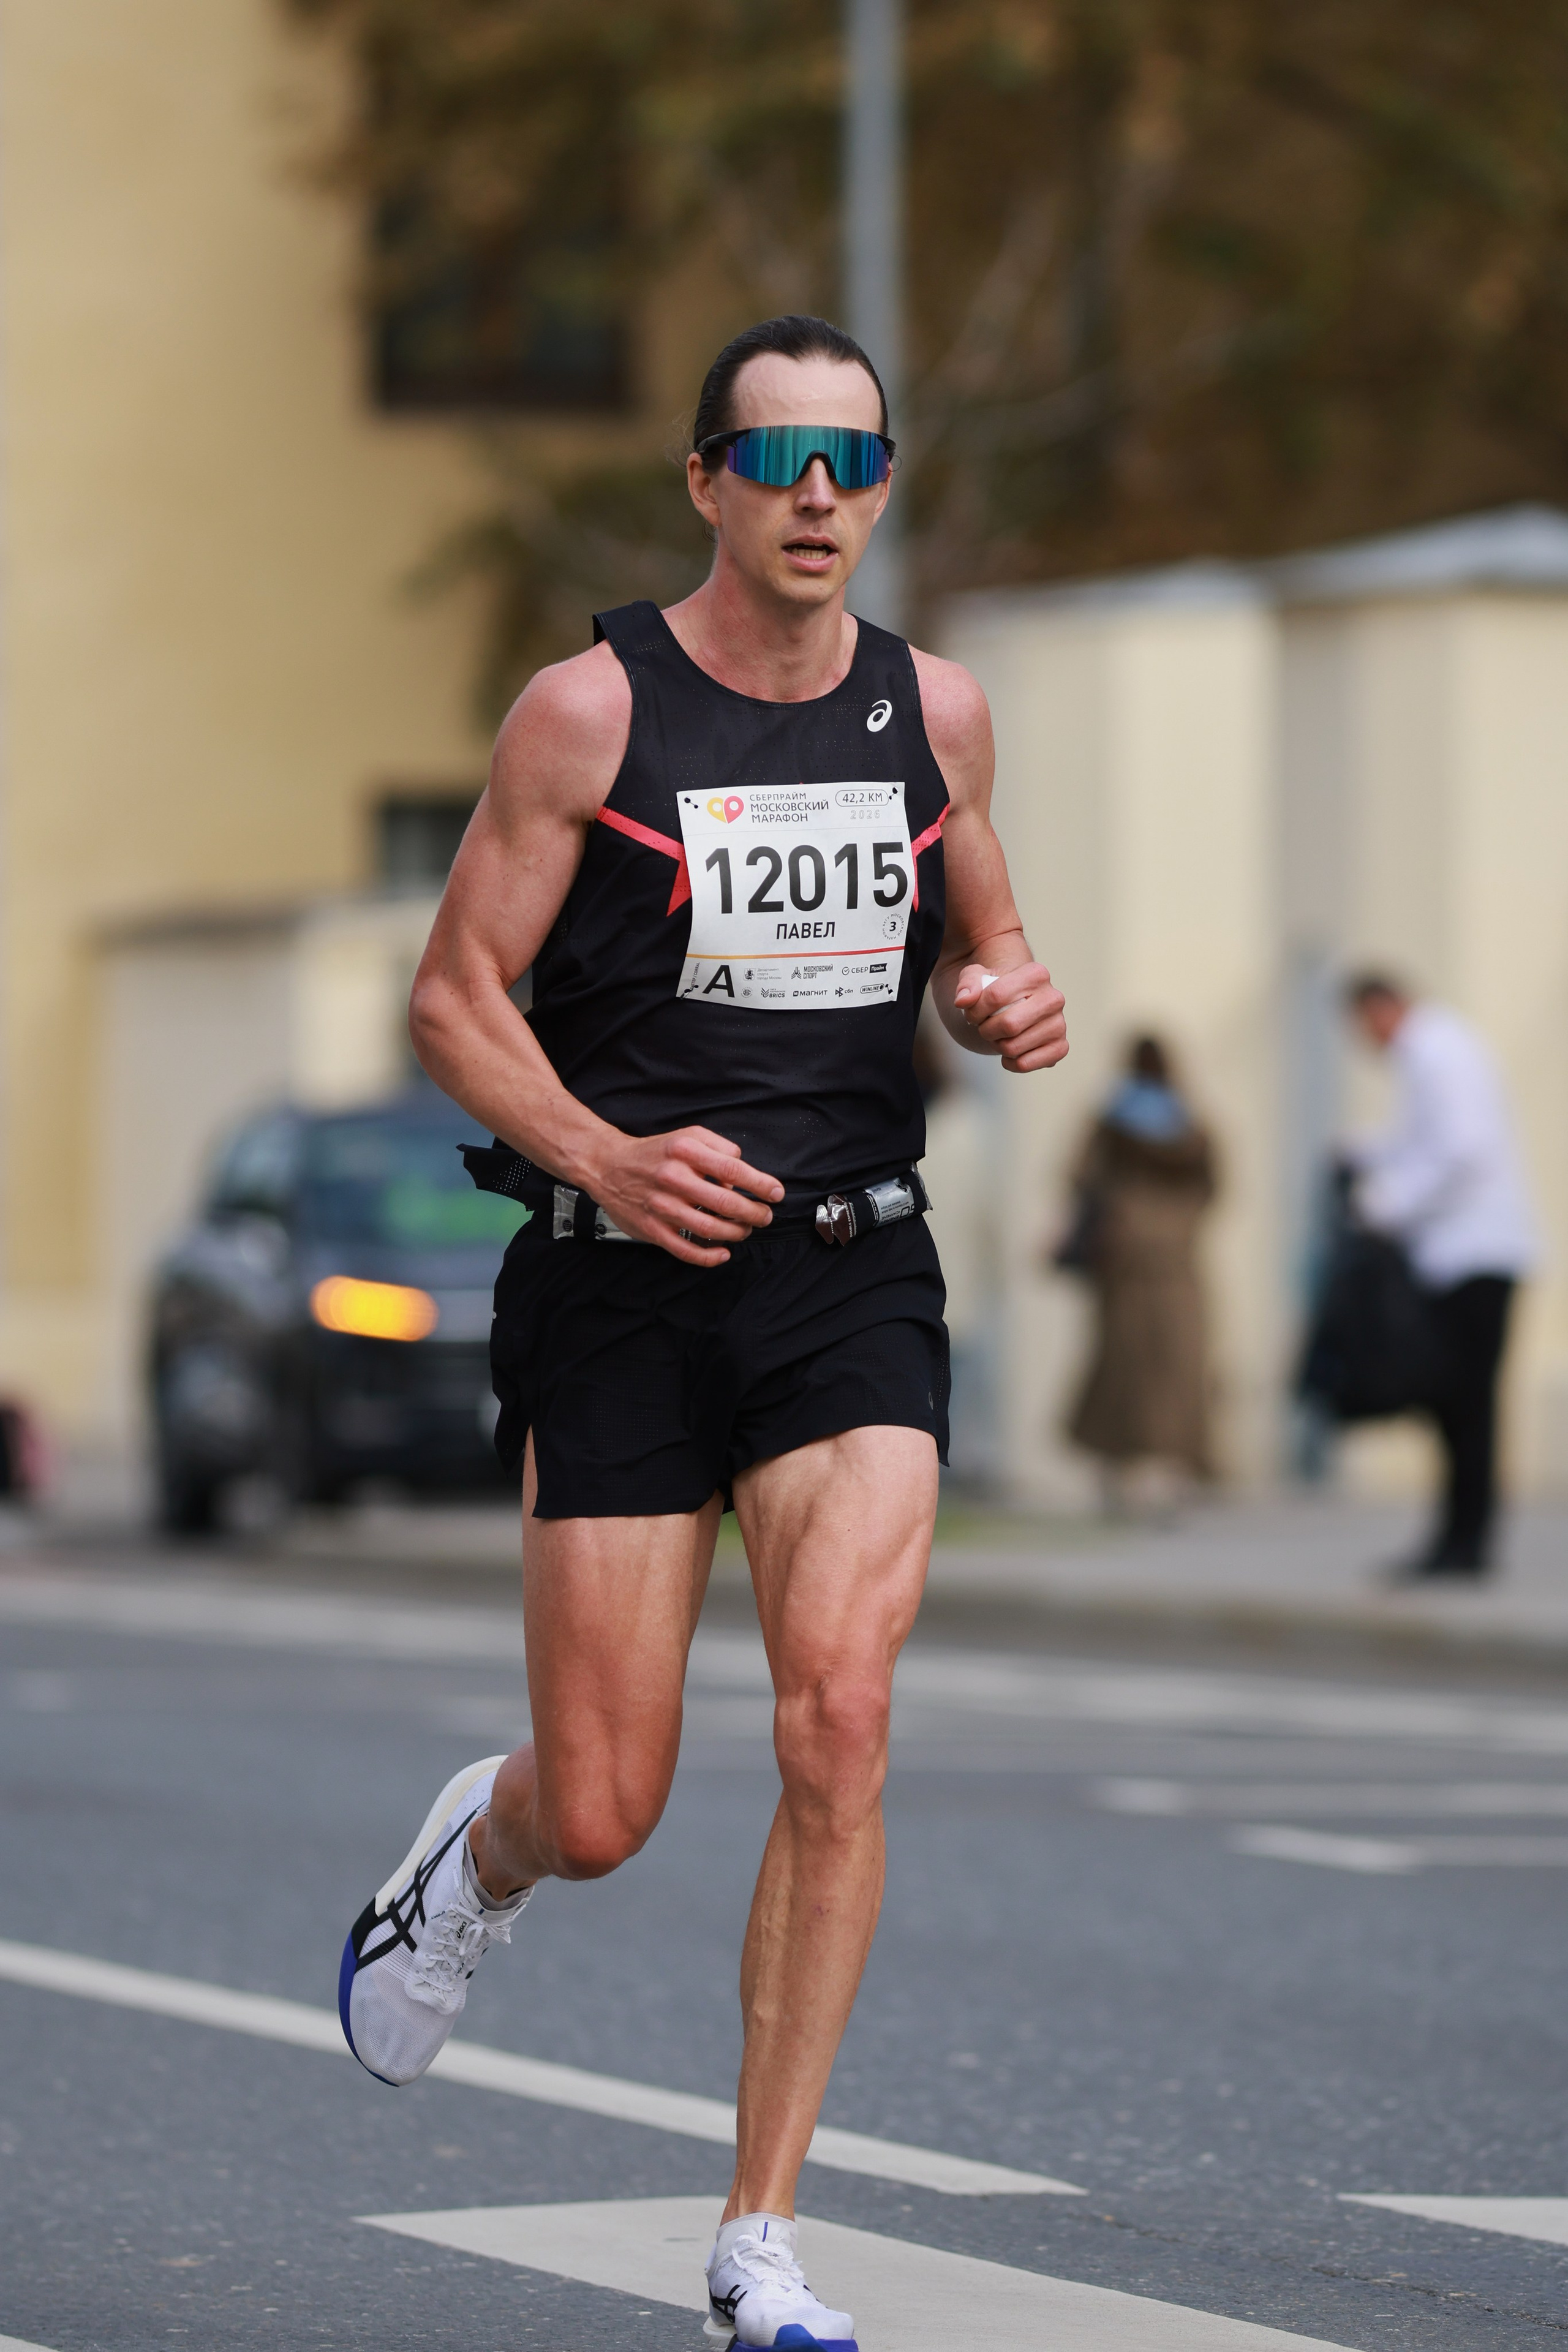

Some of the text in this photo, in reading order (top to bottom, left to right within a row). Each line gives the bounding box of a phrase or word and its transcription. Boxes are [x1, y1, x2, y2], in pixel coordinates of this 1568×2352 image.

[750, 793, 807, 801] СБЕРПРАЙМ
[842, 793, 865, 804] 42,2
[750, 799, 829, 812] МОСКОВСКИЙ
[752, 813, 808, 823] МАРАФОН
[850, 810, 880, 820] 2026
[706, 842, 908, 914] 12015
[777, 922, 835, 940] ПАВЕЛ
[889, 921, 897, 932] 3
